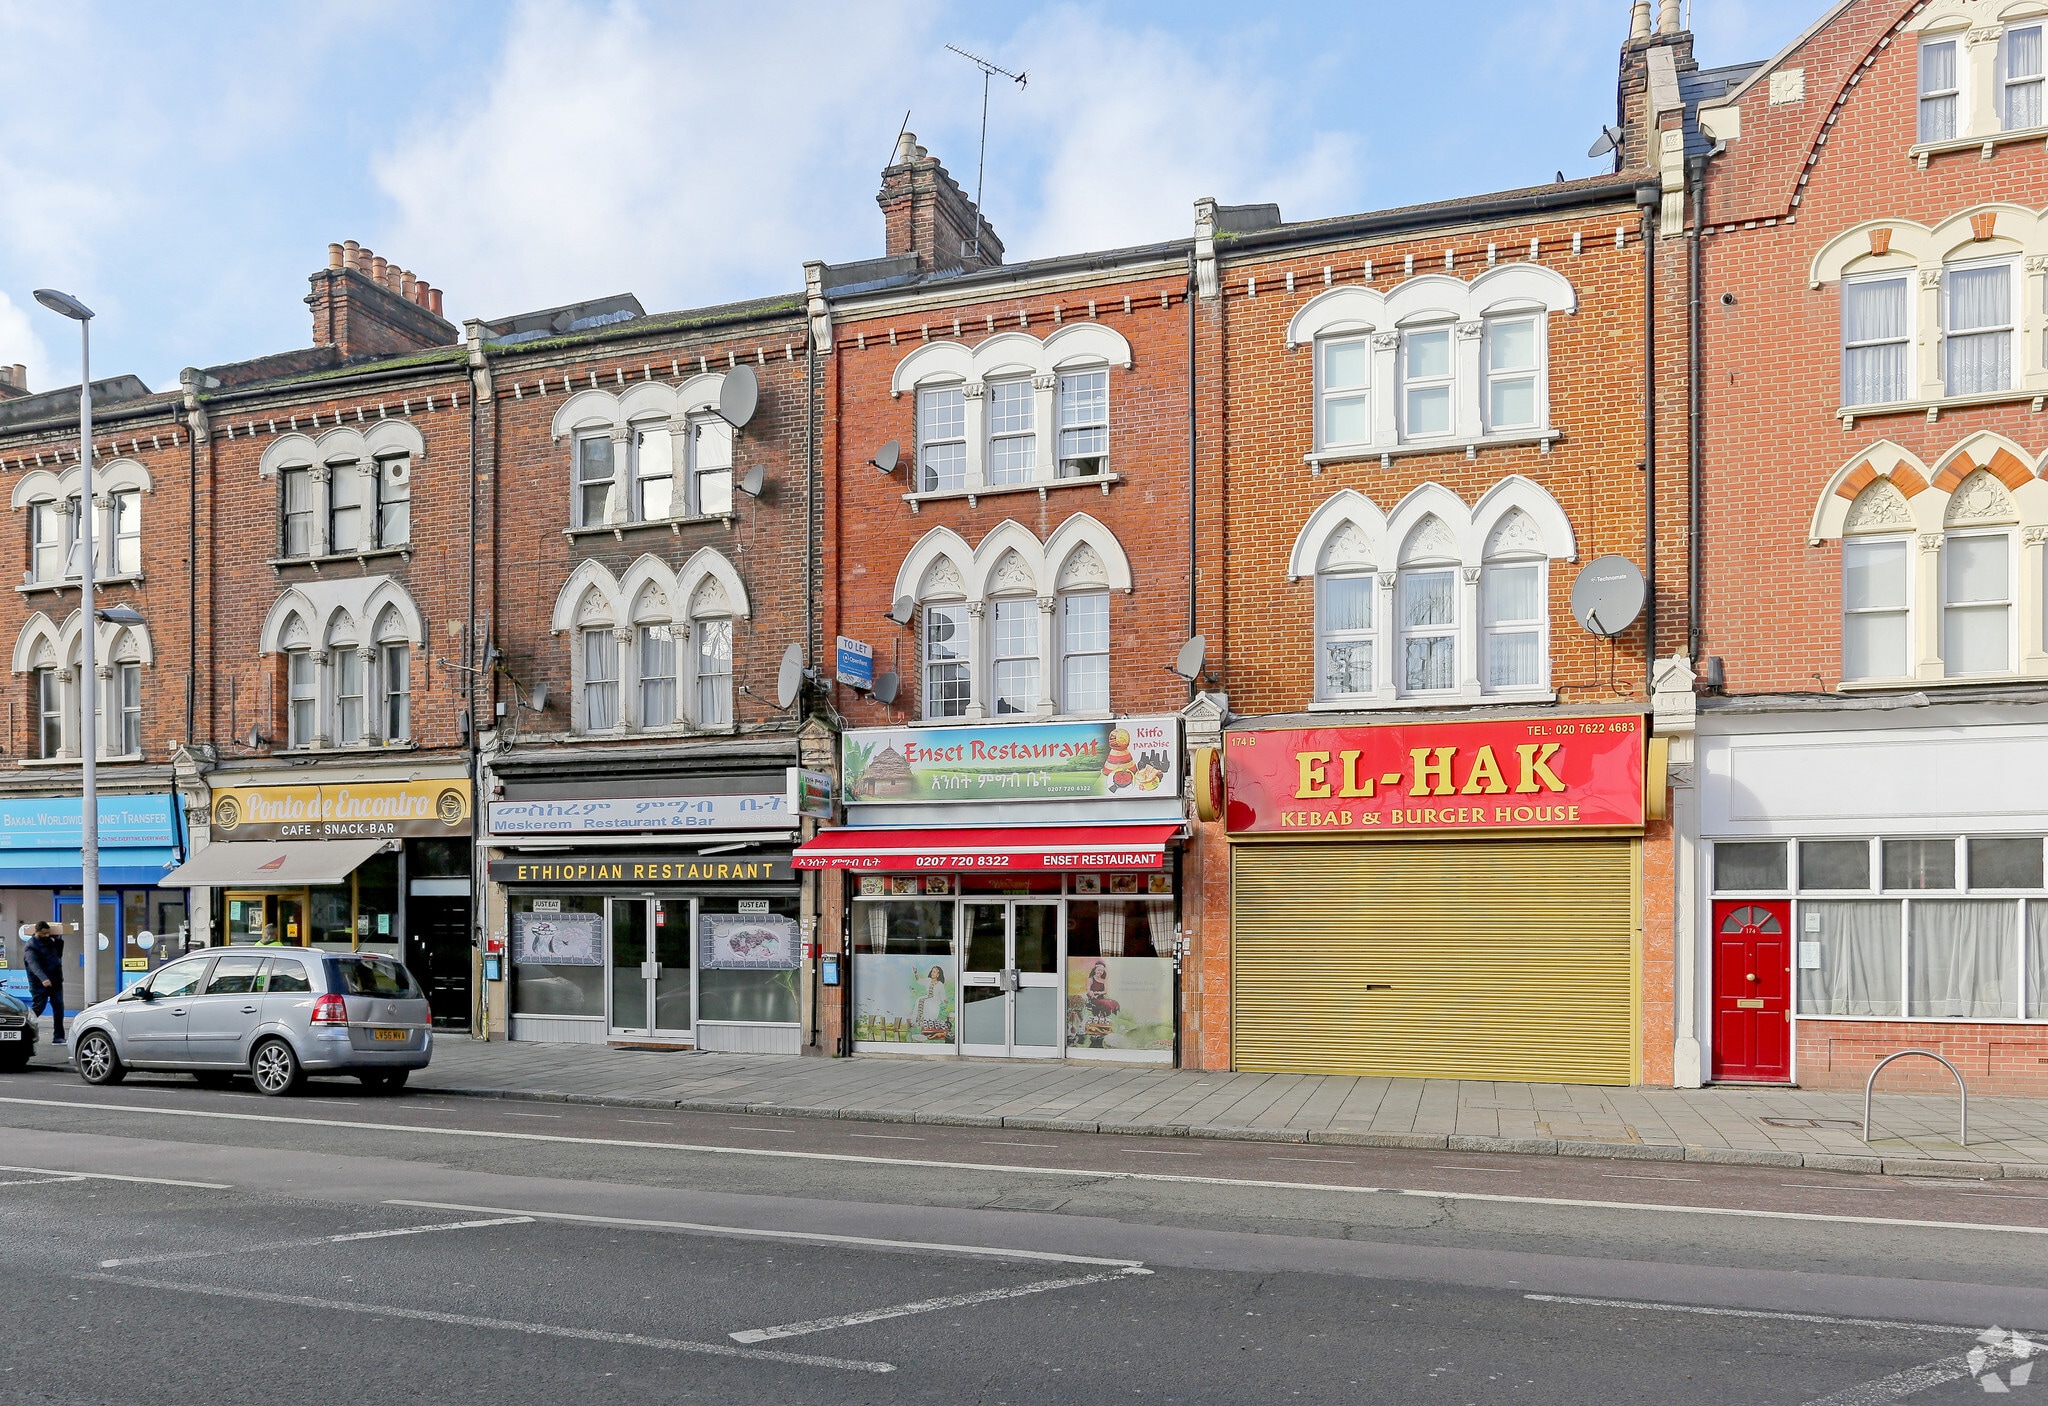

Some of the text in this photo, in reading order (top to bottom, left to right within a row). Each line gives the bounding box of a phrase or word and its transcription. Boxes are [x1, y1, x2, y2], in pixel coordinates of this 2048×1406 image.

[843, 639, 868, 654] TO LET
[1136, 727, 1164, 739] Kitfo
[1527, 722, 1635, 736] TEL: 020 7622 4683
[1231, 737, 1256, 746] 174 B
[904, 739, 1099, 763] Enset Restaurant
[1294, 742, 1566, 799] EL-HAK
[977, 772, 1021, 788] ምግብ
[1026, 770, 1051, 787] ቤት
[247, 789, 430, 820] Ponto de Encontro
[497, 803, 611, 817] መስከረም
[636, 800, 713, 815] ምግብ
[37, 813, 83, 826] WORLDWID
[99, 813, 121, 825] ONEY
[494, 815, 715, 830] Meskerem Restaurant & Bar
[1281, 805, 1581, 827] KEBAB & BURGER HOUSE
[281, 823, 394, 836] CAFE SNACK-BAR
[862, 857, 881, 867] ቤት
[915, 855, 1009, 867] 0207 720 8322
[1043, 853, 1157, 866] ENSET RESTAURANT
[518, 862, 774, 880] ETHIOPIAN RESTAURANT
[3, 1031, 18, 1039] BDE
